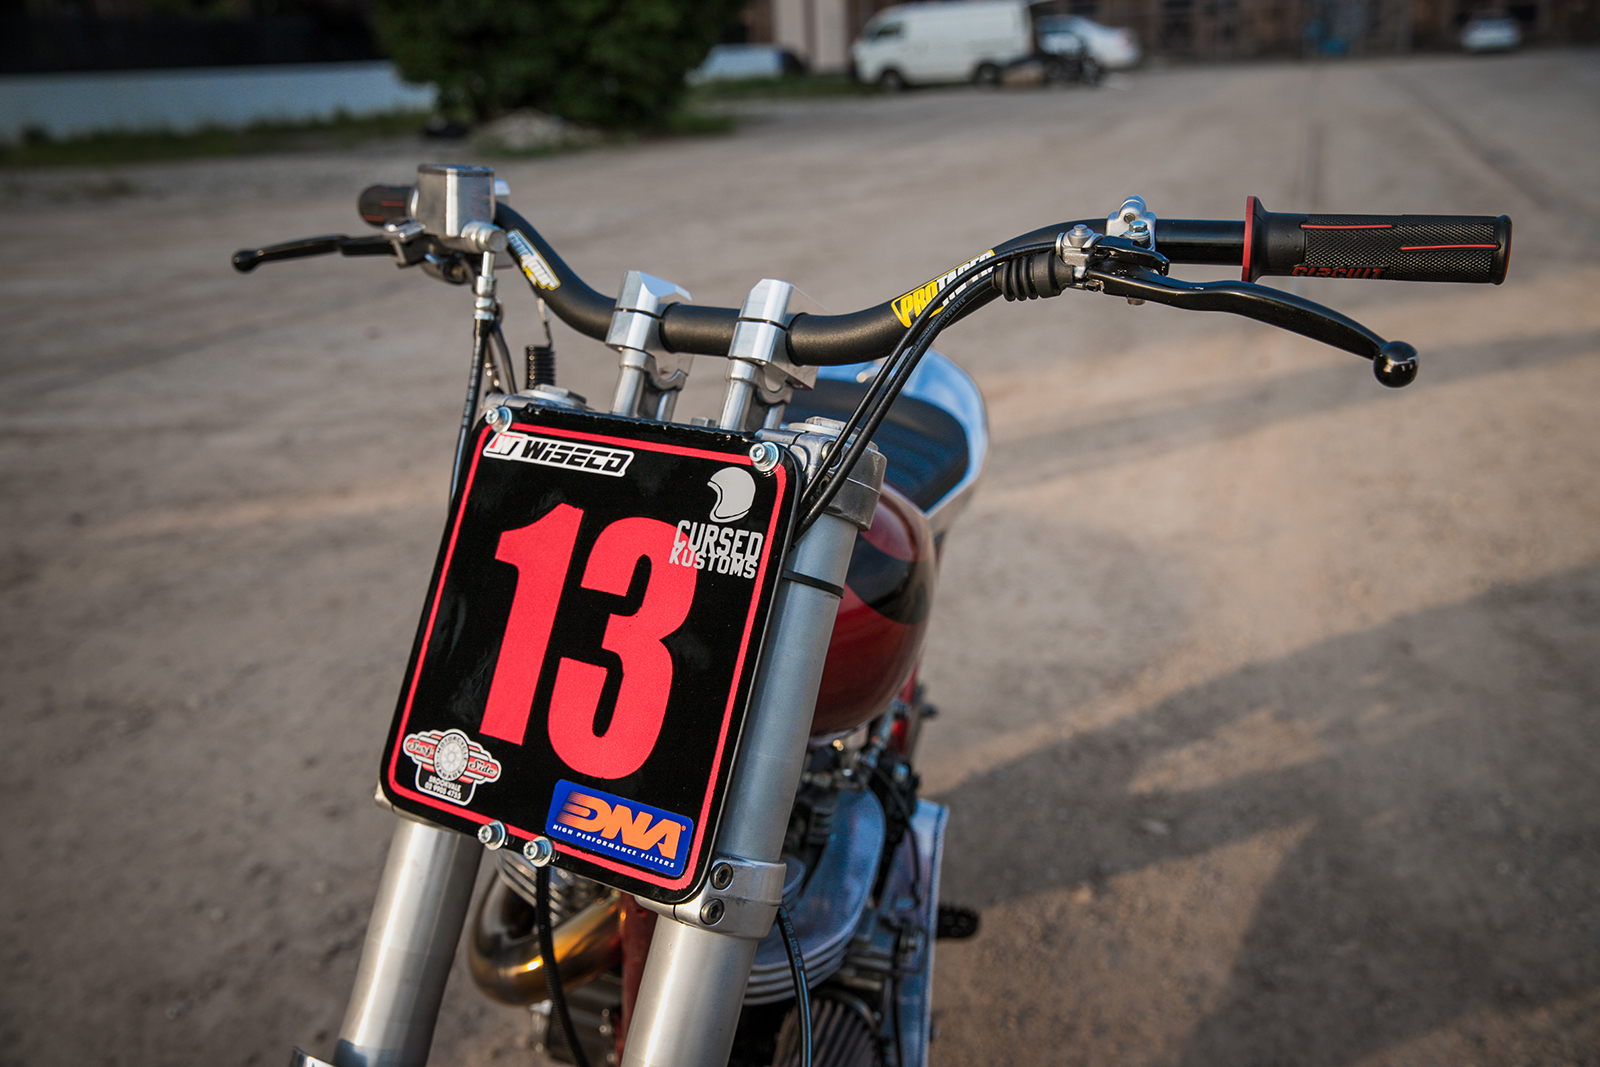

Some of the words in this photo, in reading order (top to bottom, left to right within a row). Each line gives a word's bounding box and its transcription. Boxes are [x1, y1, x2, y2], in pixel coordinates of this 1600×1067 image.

[1291, 266, 1383, 278] CIRCUIT
[672, 520, 764, 561] CURSED
[668, 547, 759, 579] KUSTOMS
[479, 503, 697, 779] 13
[408, 741, 433, 755] Surf
[437, 735, 468, 761] MOTORCYCLE
[469, 760, 494, 775] Side
[556, 791, 681, 860] DNA
[552, 824, 573, 836] HIGH
[576, 832, 638, 857] PERFORMANCE
[640, 853, 675, 869] FILTERS
